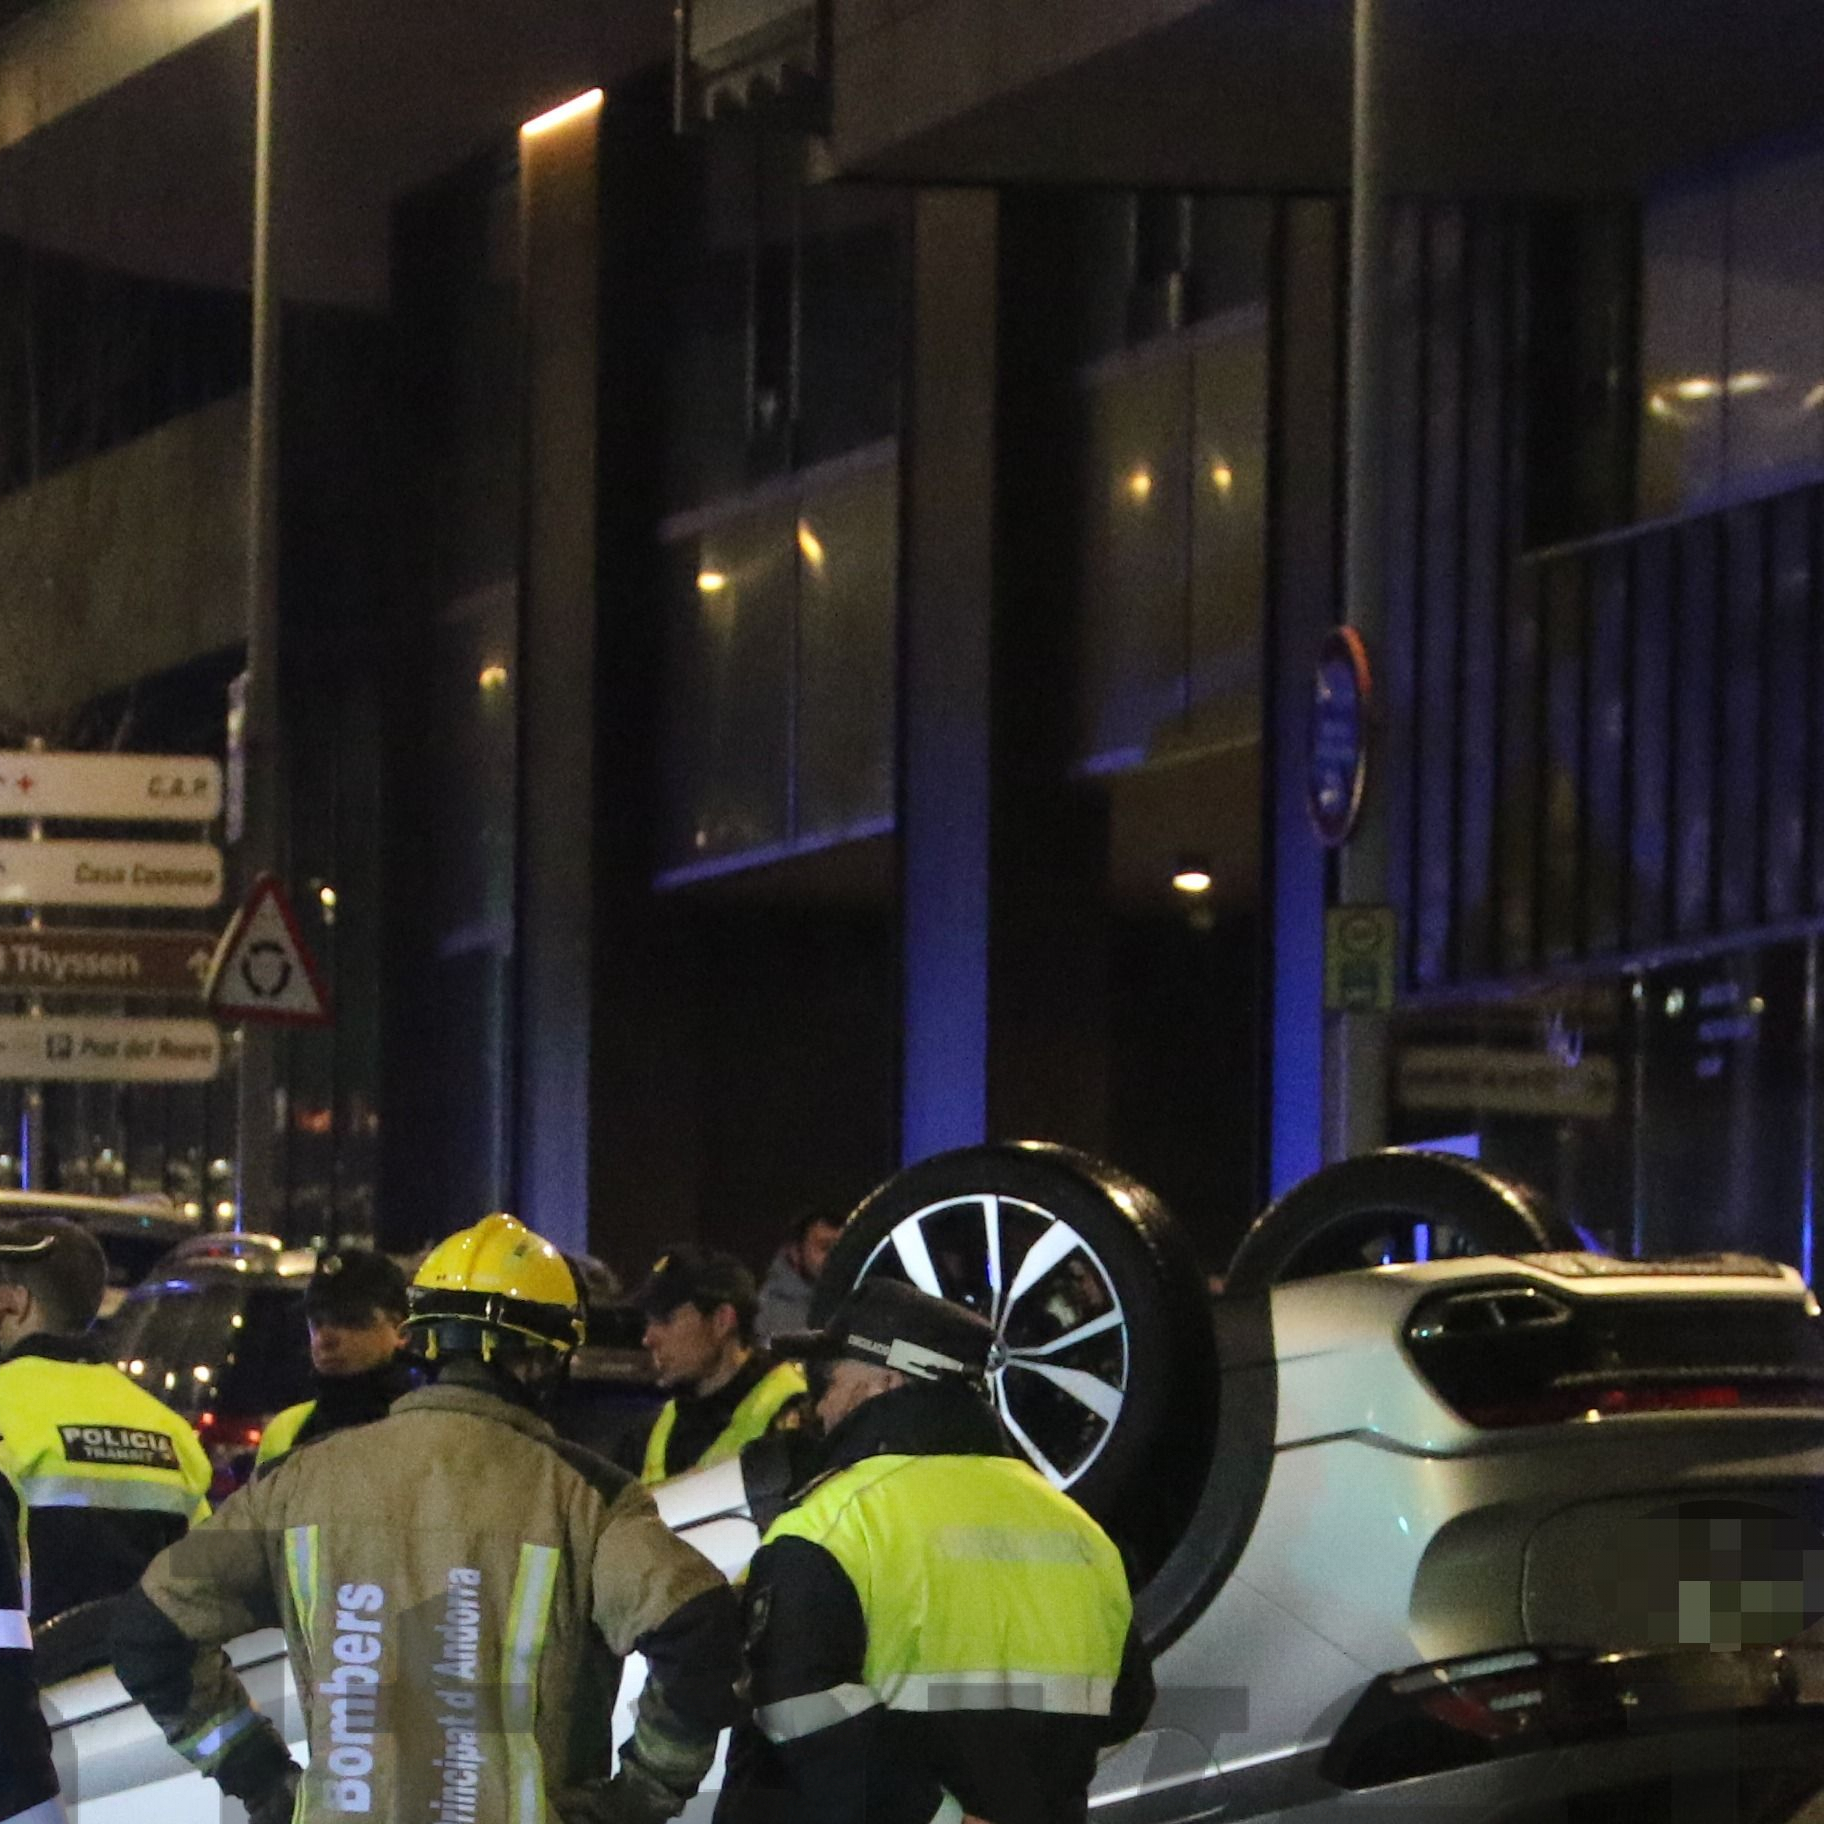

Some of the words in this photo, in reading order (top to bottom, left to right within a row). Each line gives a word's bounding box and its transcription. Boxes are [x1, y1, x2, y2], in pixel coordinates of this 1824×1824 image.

[10, 944, 139, 981] Thyssen
[61, 1427, 175, 1453] POLICIA
[320, 1583, 385, 1813] Bombers
